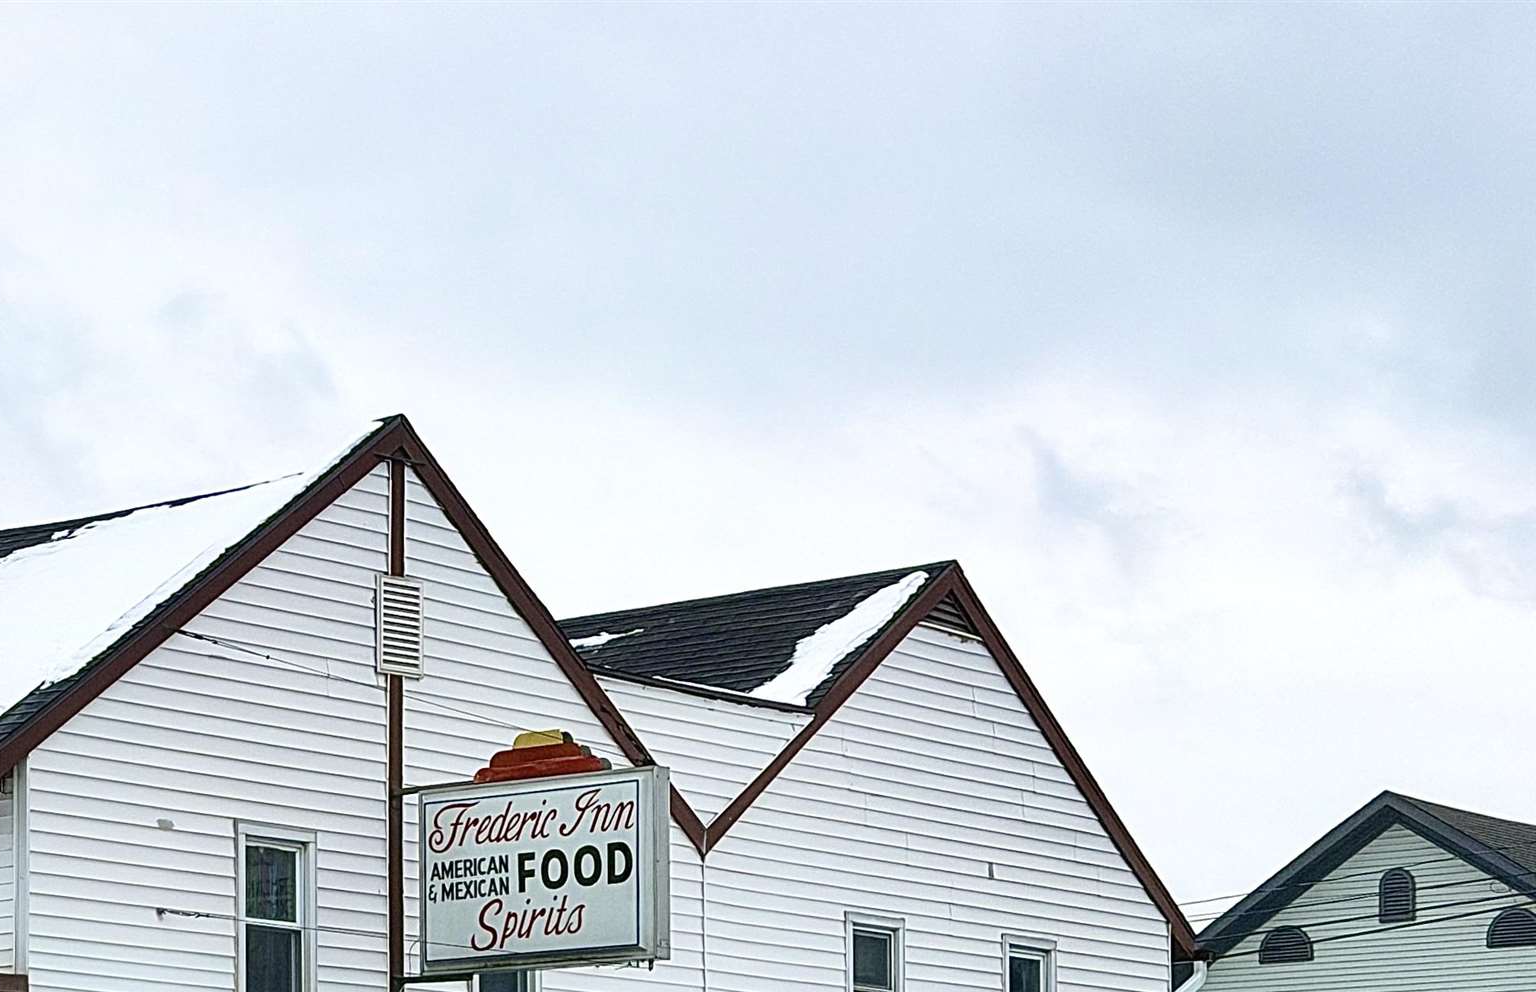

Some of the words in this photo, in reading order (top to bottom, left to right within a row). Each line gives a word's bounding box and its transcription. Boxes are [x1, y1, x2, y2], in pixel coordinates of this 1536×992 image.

[429, 800, 556, 853] Frederic
[559, 788, 635, 837] Inn
[428, 884, 437, 903] &
[441, 877, 510, 902] MEXICAN
[431, 854, 509, 881] AMERICAN
[517, 841, 633, 893] FOOD
[471, 895, 586, 951] Spirits
